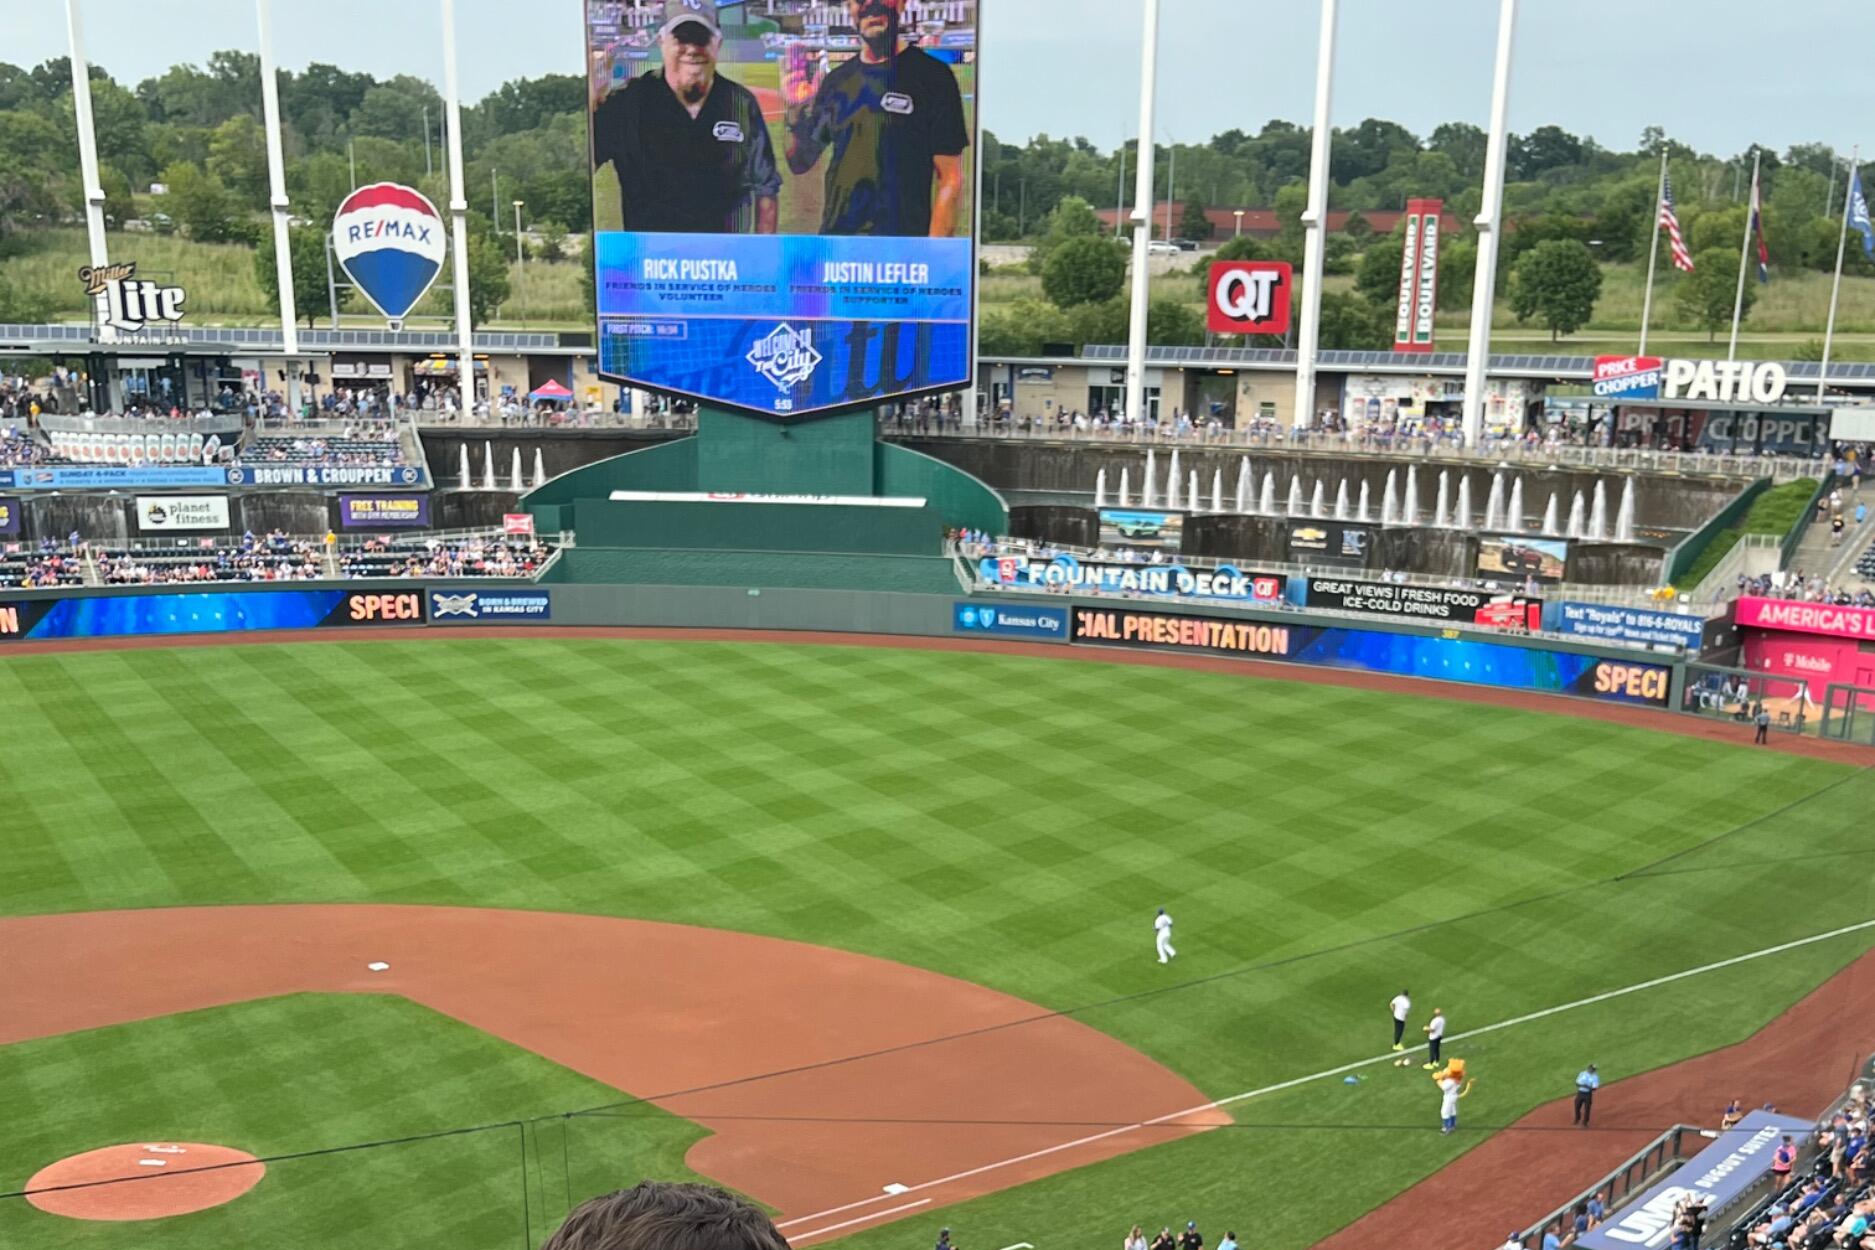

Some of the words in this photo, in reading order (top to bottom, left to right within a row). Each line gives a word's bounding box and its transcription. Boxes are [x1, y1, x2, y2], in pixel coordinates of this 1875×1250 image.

[349, 220, 430, 244] RE/MAX
[79, 262, 136, 294] Miller
[644, 259, 678, 280] RICK
[681, 260, 737, 281] PUSTKA
[823, 262, 873, 283] JUSTIN
[877, 263, 928, 284] LEFLER
[1397, 224, 1416, 332] BOULEVARD
[1416, 224, 1437, 332] BOULEVARD
[605, 282, 652, 290] FRIENDS
[668, 283, 715, 291] SERVICE
[717, 284, 731, 292] OF
[789, 285, 836, 294] FRIENDS
[853, 287, 899, 295] SERVICE
[918, 288, 962, 296] HEROES
[1216, 269, 1280, 321] QT
[105, 280, 186, 331] Lite
[771, 349, 815, 381] City
[1597, 358, 1637, 377] PRICE
[1594, 372, 1658, 396] CHOPPER
[1664, 359, 1786, 402] PATIO
[254, 469, 303, 484] BROWN
[307, 469, 318, 482] &
[322, 469, 392, 483] CROUPPEN
[169, 502, 210, 514] planet
[176, 511, 219, 524] fitness
[350, 500, 374, 511] FREE
[375, 500, 418, 511] TRAINING
[1342, 529, 1367, 555] KC
[1028, 563, 1168, 592] FOUNTAIN
[1176, 573, 1250, 596] DECK
[1255, 581, 1274, 596] QT
[1313, 581, 1353, 594] GREAT
[1355, 585, 1393, 599] VIEWS
[1401, 587, 1441, 604] FRESH
[1444, 592, 1479, 607] FOOD
[349, 595, 419, 620] SPECI
[1343, 597, 1401, 612] ICE-COLD
[1404, 602, 1450, 617] DRINKS
[1565, 606, 1585, 620] Text
[1585, 608, 1625, 625] "Royals"
[1626, 613, 1636, 626] to
[1758, 603, 1863, 634] AMERICA'S
[998, 614, 1037, 628] Kansas
[1038, 617, 1060, 631] City
[1123, 615, 1289, 655] PRESENTATION
[1795, 654, 1832, 672] Mobile
[1594, 663, 1669, 700] SPECI
[1695, 1152, 1747, 1189] DUGOUT
[1739, 1125, 1780, 1156] SUITES
